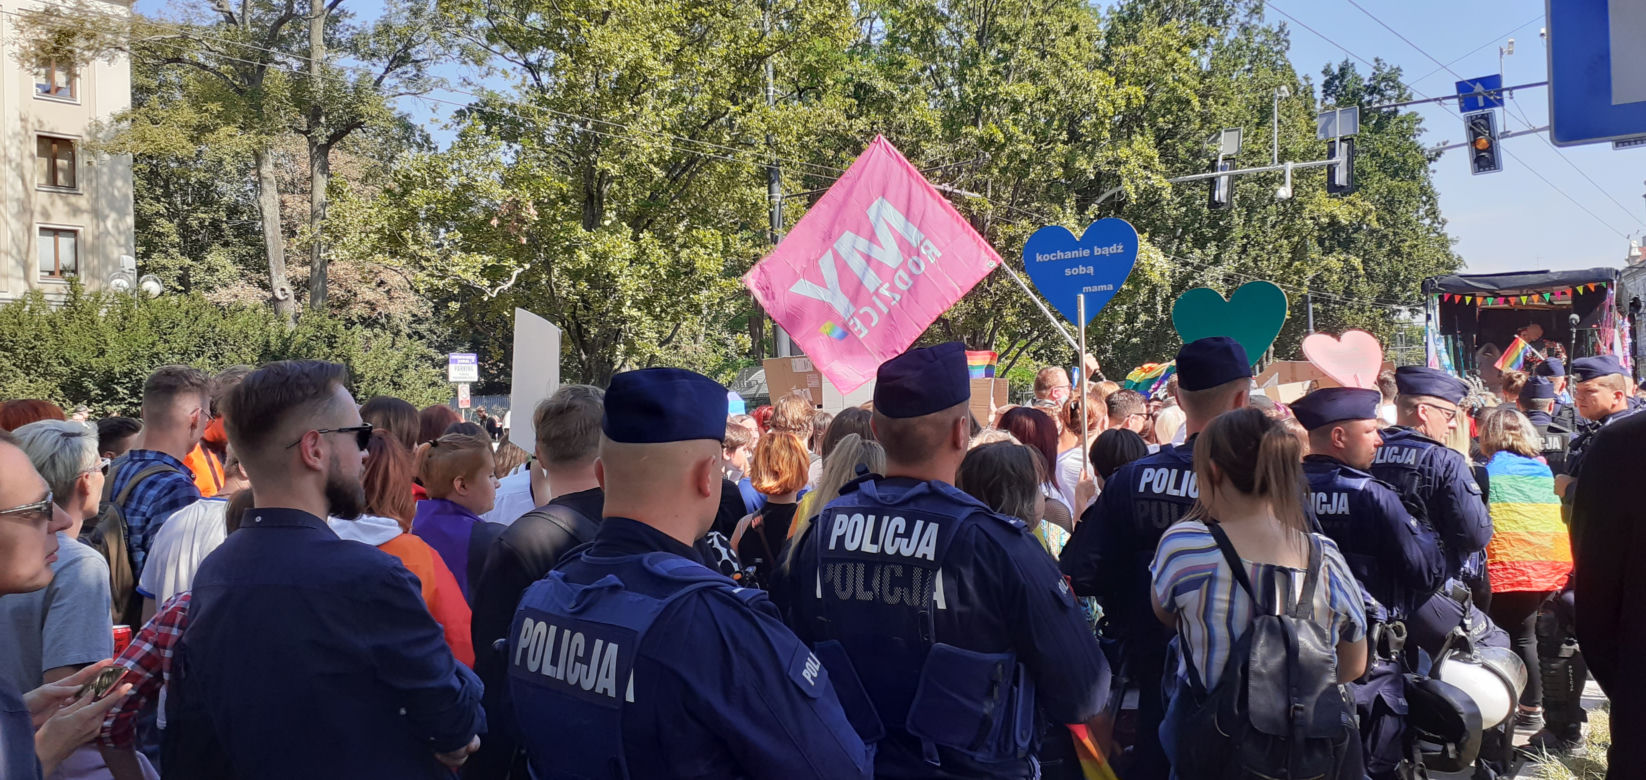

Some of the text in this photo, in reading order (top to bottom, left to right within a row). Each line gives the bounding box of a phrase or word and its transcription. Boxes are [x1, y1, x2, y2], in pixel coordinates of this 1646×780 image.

[1036, 242, 1124, 262] kochanie bądź
[1065, 265, 1094, 276] sobą
[1082, 283, 1114, 293] mama
[1374, 446, 1418, 465] LICJA
[1138, 467, 1199, 498] POLIC
[1310, 491, 1350, 515] ICJA
[828, 513, 939, 561] POLICJA
[514, 617, 618, 698] POLICJA
[802, 651, 821, 686] POLI
